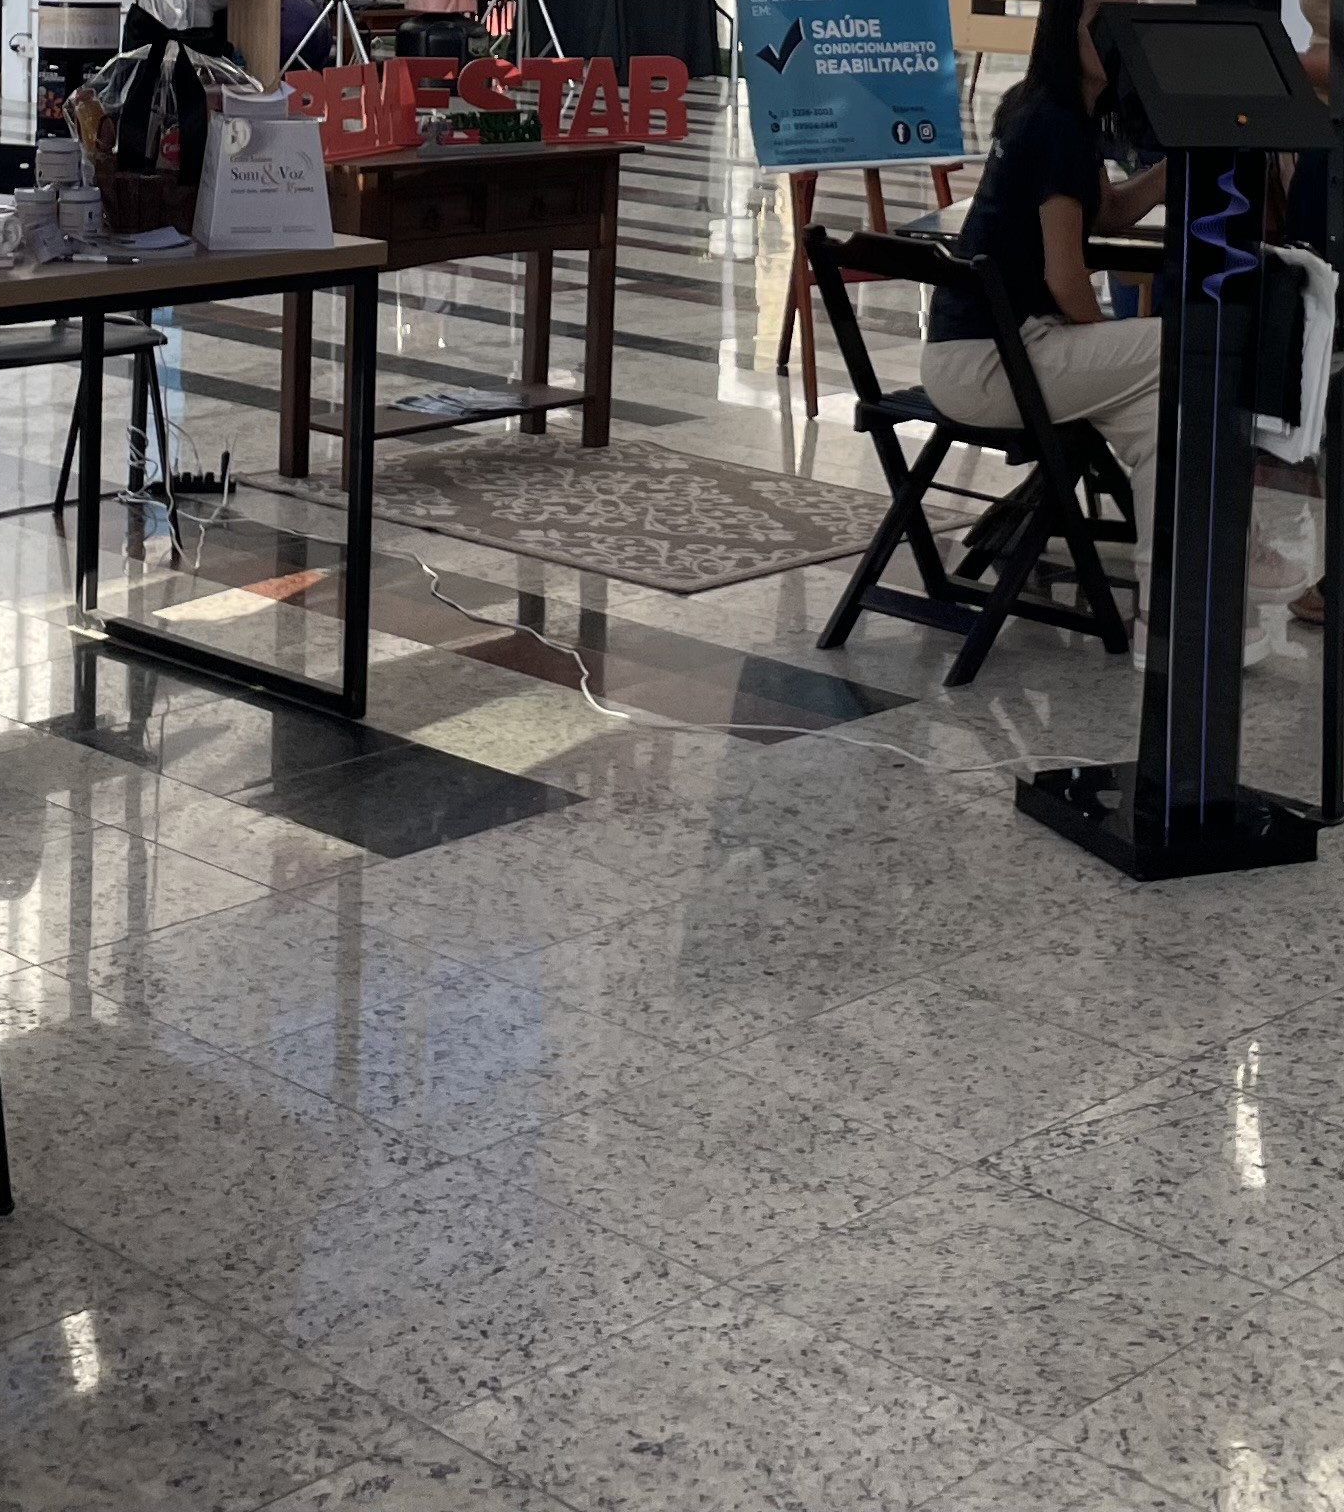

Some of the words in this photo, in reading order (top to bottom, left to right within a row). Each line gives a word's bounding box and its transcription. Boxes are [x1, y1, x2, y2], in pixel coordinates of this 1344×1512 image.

[811, 14, 882, 39] SAÚDE
[813, 40, 937, 56] CONDICIONAMENTO
[815, 54, 940, 76] REABILITAÇÃO
[402, 55, 689, 139] ESTAR
[231, 167, 259, 181] Som
[279, 166, 305, 181] Voz
